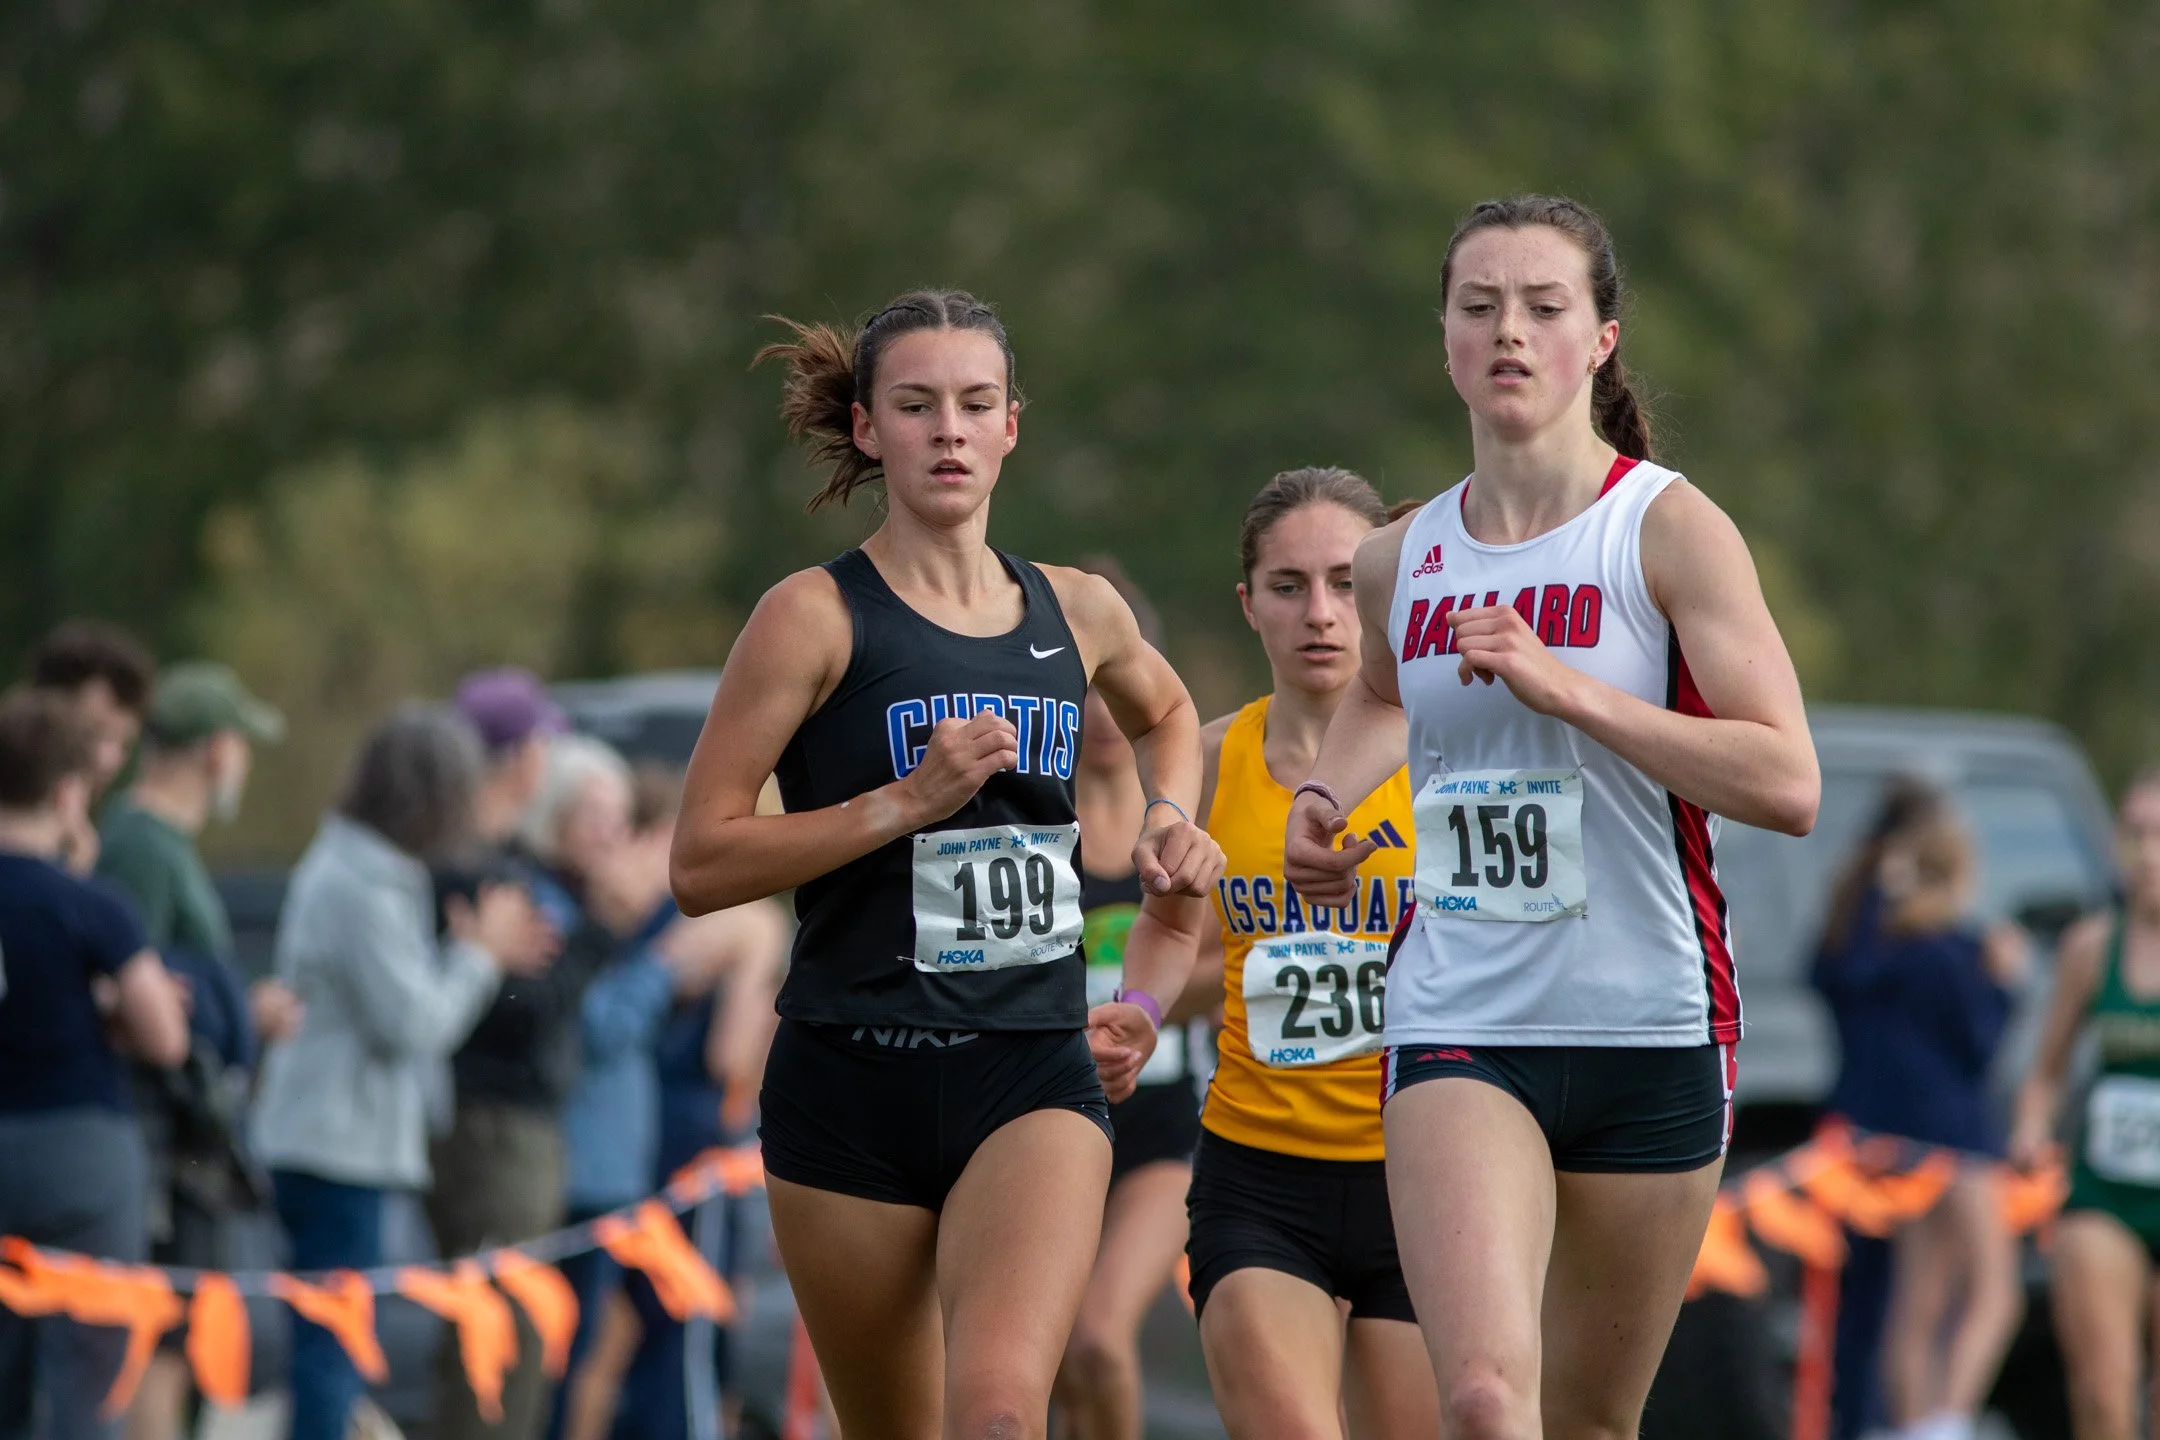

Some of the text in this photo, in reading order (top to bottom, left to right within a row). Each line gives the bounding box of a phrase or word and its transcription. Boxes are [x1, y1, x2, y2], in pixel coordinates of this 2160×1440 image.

[1412, 563, 1444, 578] adidas
[1401, 583, 1603, 664] BAARD
[1460, 780, 1490, 794] PAYNE
[1527, 780, 1562, 794] INVITE
[937, 841, 967, 856] JOHN
[968, 837, 1002, 853] PAYNE
[1030, 832, 1062, 845] INVITE
[1448, 803, 1549, 889] 159
[953, 853, 1055, 941] 199
[1435, 896, 1555, 912] HOKA ROUTE
[937, 942, 1056, 965] HOKA ROUTE
[1267, 943, 1291, 958] JOHN
[1294, 942, 1328, 956] PAYNE
[1275, 960, 1386, 1040] 236
[1270, 1047, 1316, 1063] HOKA
